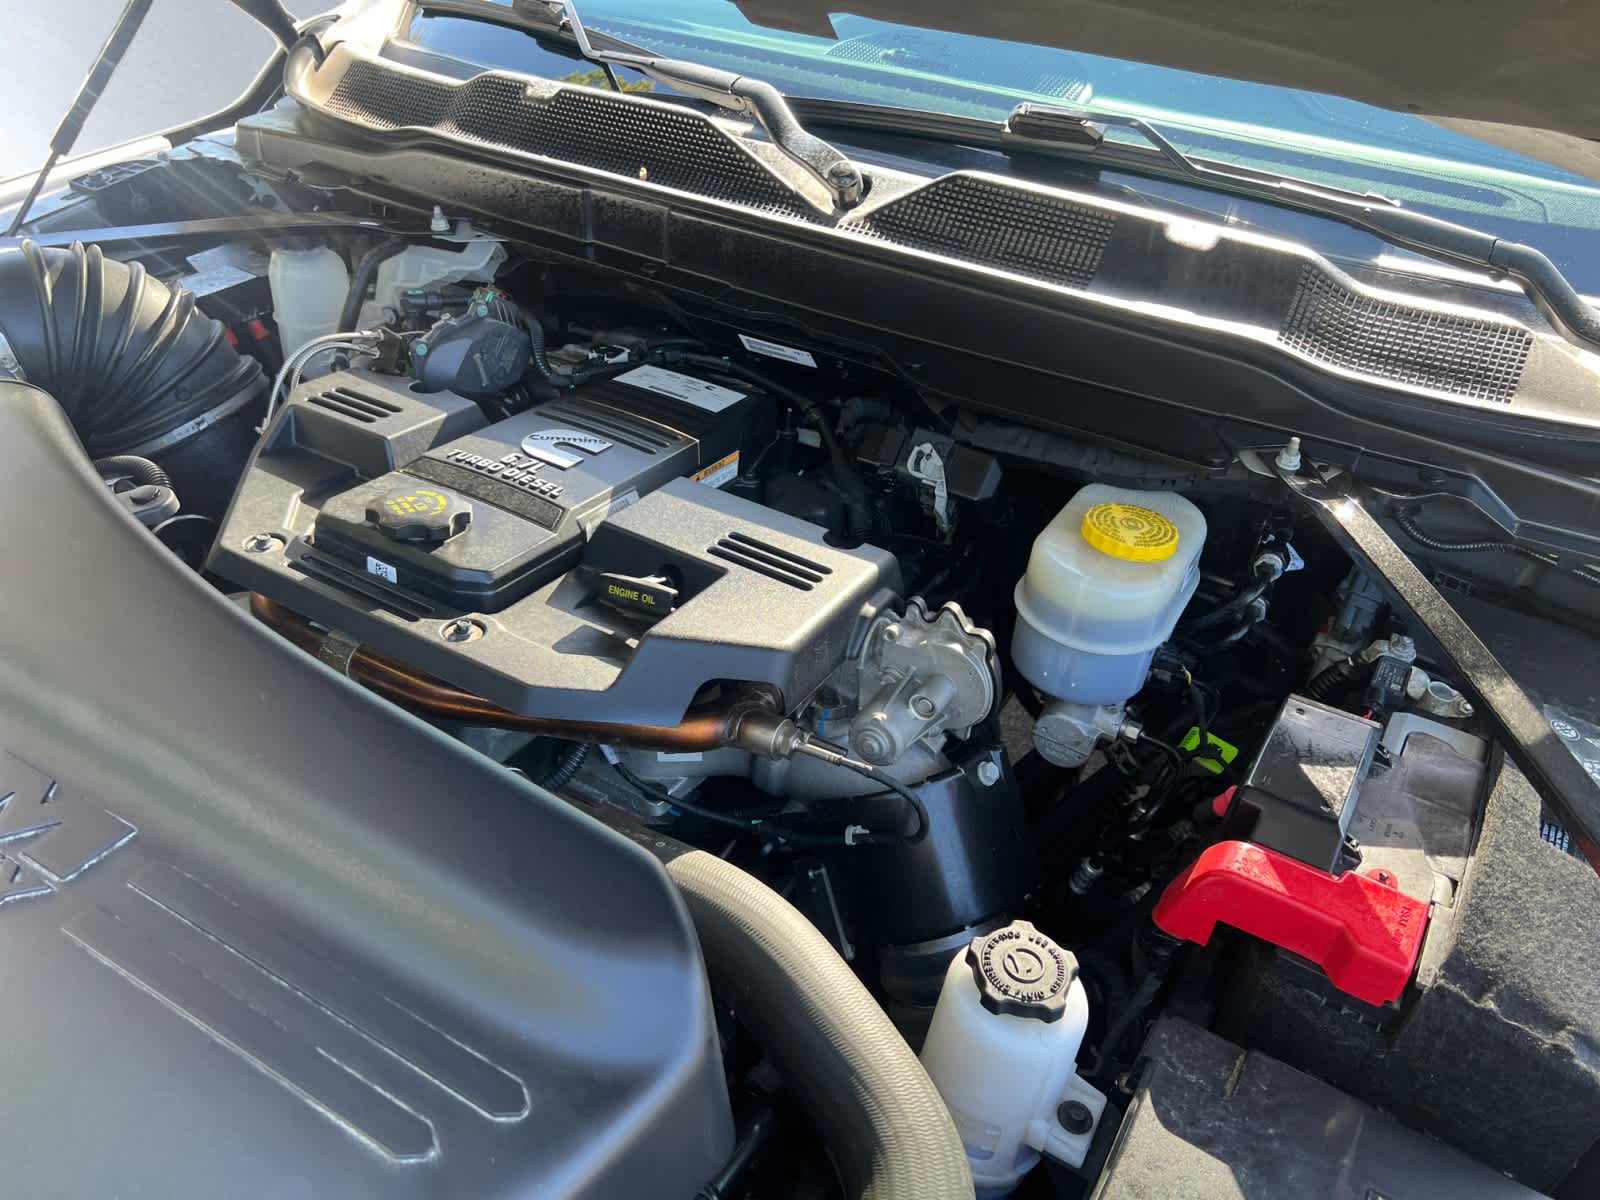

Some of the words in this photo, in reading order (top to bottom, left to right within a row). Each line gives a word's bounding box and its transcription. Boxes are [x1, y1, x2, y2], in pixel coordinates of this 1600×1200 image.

[528, 433, 608, 445] Cummins
[446, 449, 504, 475] TURBO
[502, 466, 565, 498] DIESEL
[500, 452, 546, 474] 6.7L
[608, 584, 639, 601] ENGINE
[641, 593, 656, 605] OIL
